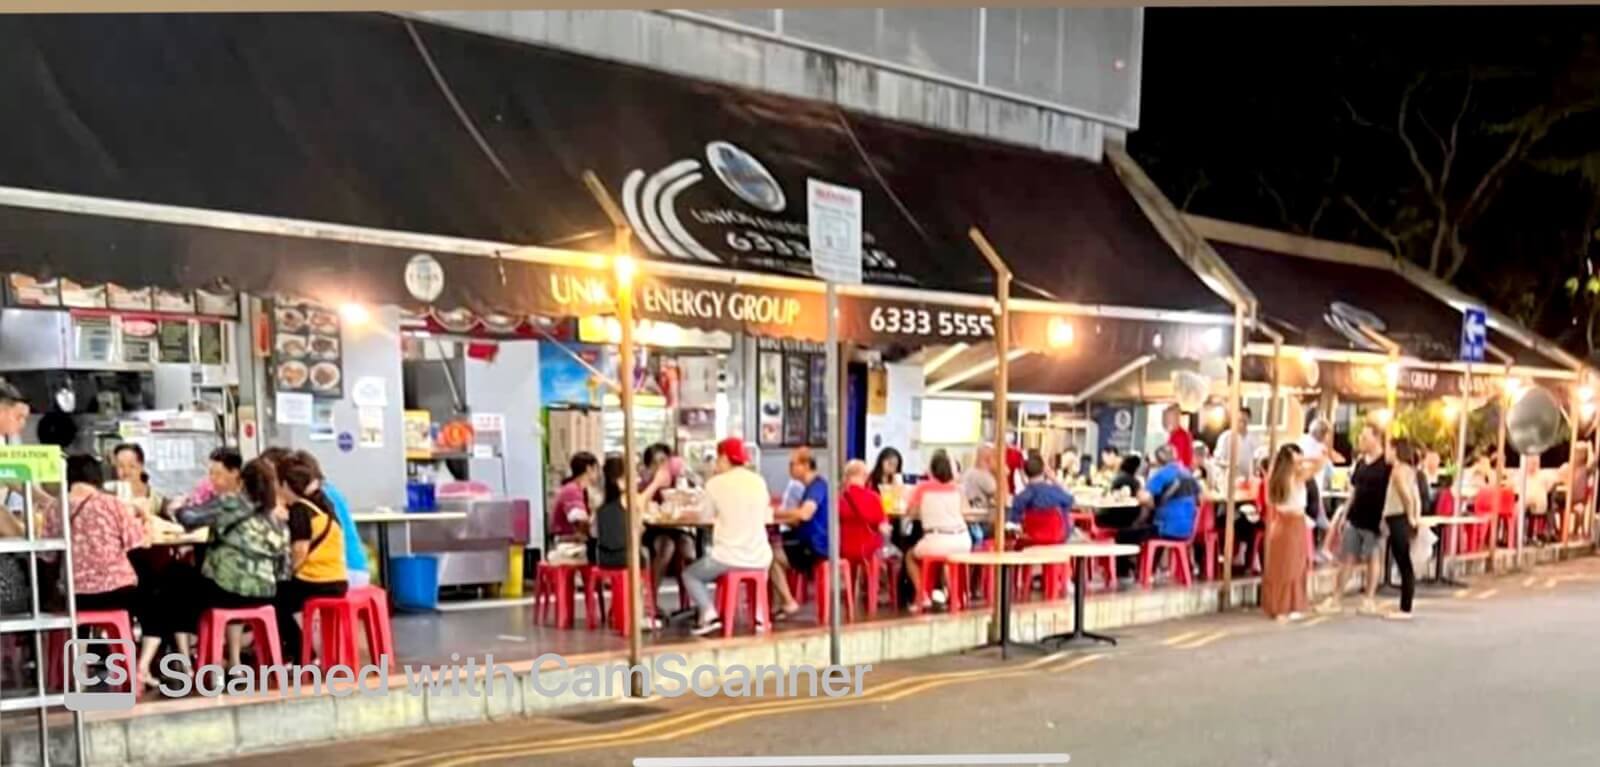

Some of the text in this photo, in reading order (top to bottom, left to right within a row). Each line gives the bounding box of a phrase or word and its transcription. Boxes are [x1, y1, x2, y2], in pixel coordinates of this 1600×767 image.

[642, 284, 726, 319] ENERGY
[728, 291, 801, 326] GROUP
[870, 306, 995, 337] 6333 5555
